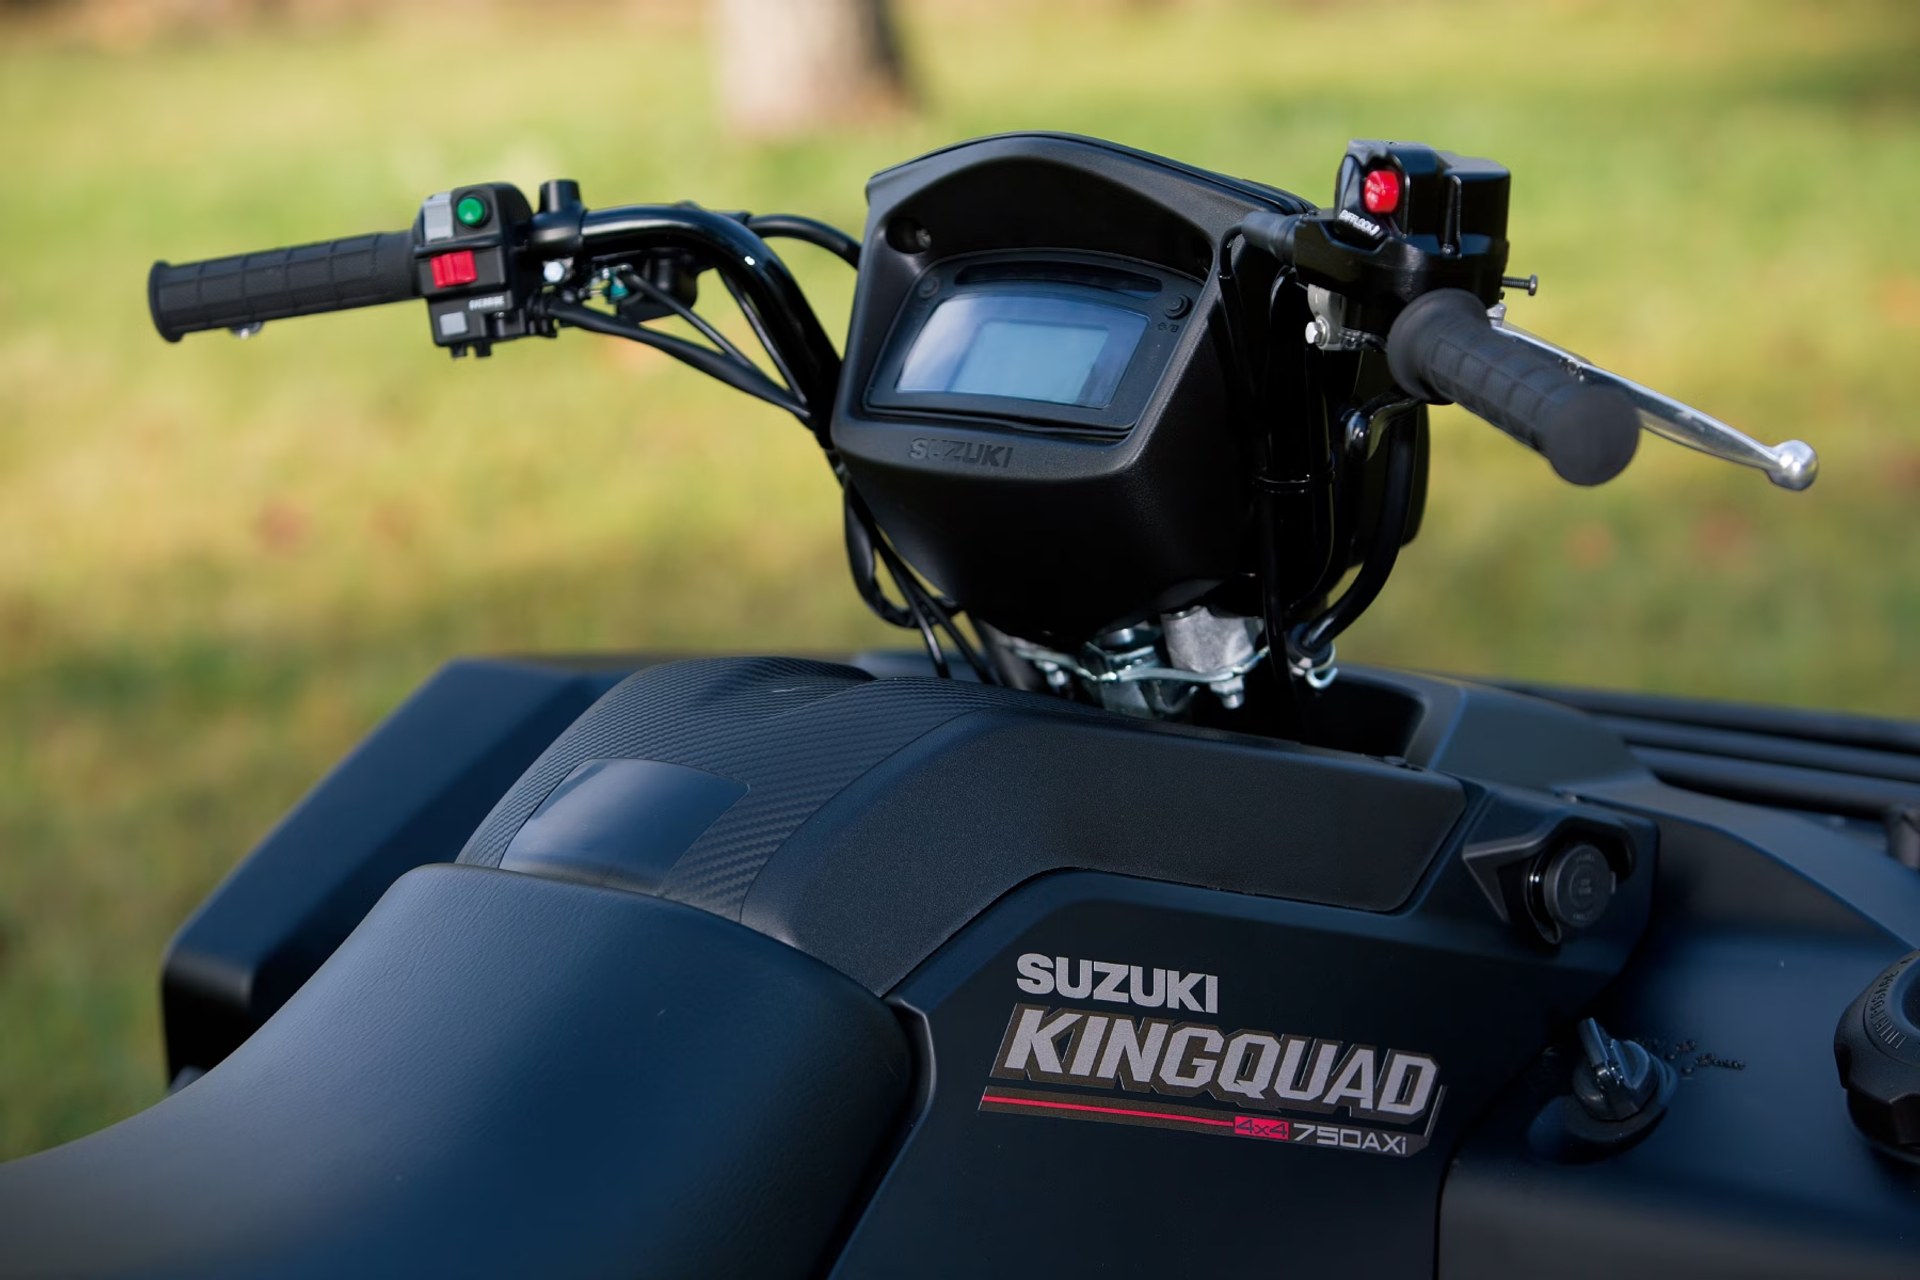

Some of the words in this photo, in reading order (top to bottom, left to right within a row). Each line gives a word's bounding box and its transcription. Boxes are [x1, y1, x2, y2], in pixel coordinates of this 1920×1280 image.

[910, 438, 1013, 468] SUZUKI
[1016, 953, 1218, 1014] SUZUKI
[1004, 1010, 1436, 1116] KINGQUAD
[1237, 1120, 1287, 1140] 4x4
[1294, 1123, 1406, 1154] 750AXi
